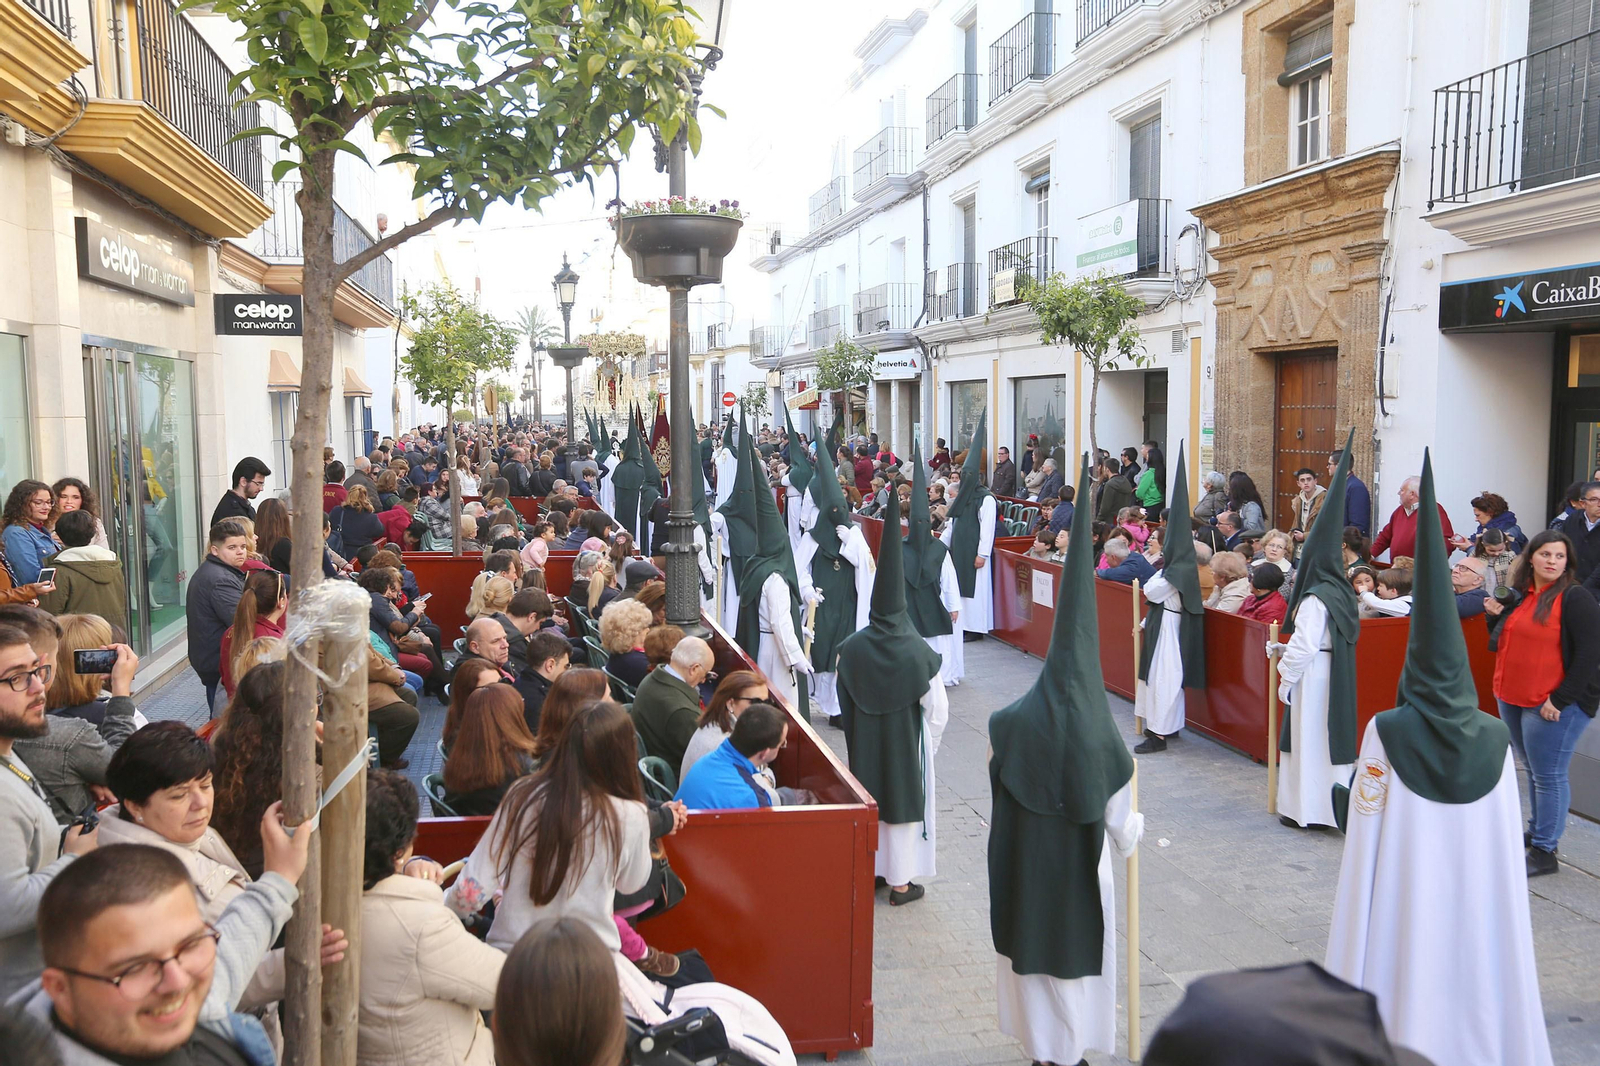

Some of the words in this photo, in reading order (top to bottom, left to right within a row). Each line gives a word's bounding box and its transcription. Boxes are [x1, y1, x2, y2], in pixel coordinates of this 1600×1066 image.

[100, 235, 139, 285] celop
[234, 300, 293, 322] celop
[877, 360, 908, 368] helvetia
[1206, 366, 1211, 378] 9
